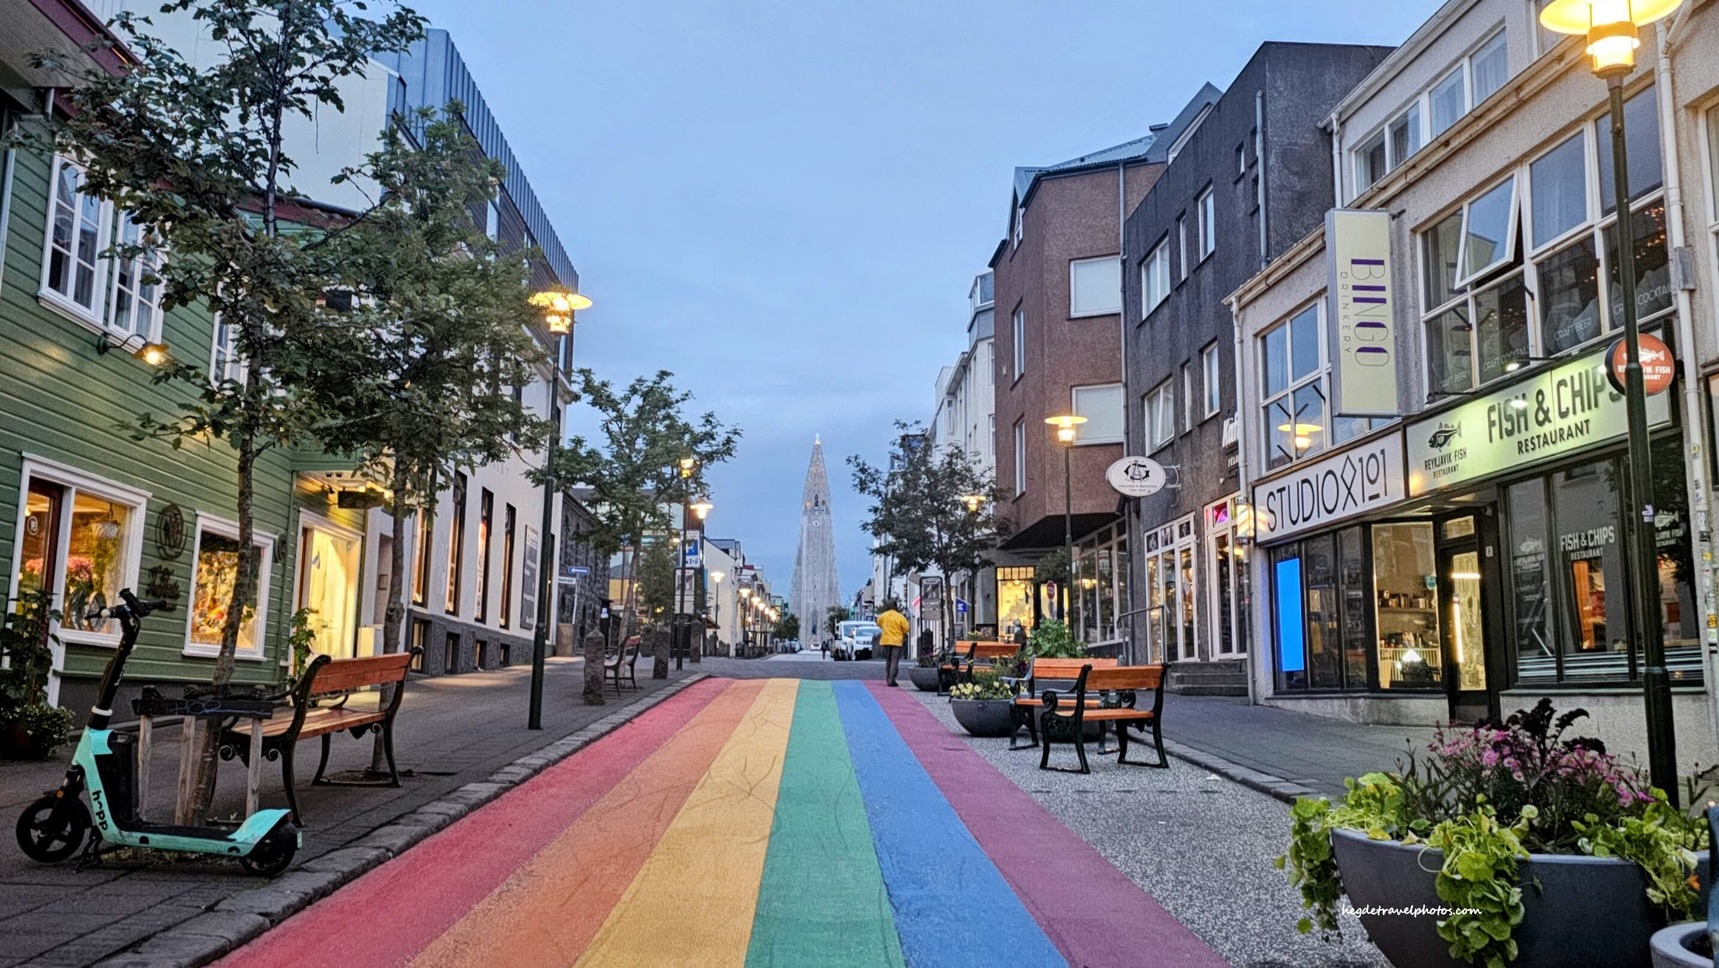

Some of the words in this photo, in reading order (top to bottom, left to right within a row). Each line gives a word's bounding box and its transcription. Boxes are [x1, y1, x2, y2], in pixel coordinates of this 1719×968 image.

[1341, 271, 1351, 353] DRINKERY
[1351, 259, 1389, 366] BINGO
[1655, 365, 1671, 374] FISH
[1487, 392, 1528, 443] FISH
[1534, 388, 1552, 427] &
[1517, 418, 1591, 455] RESTAURANT
[1424, 452, 1453, 471] REYKJAVIK
[1454, 447, 1467, 462] FISH
[1433, 464, 1459, 478] RESTAURANT
[1560, 532, 1579, 552] FISH
[1580, 533, 1587, 547] &
[1588, 525, 1615, 547] CHIPS
[1570, 547, 1604, 560] RESTAURANT
